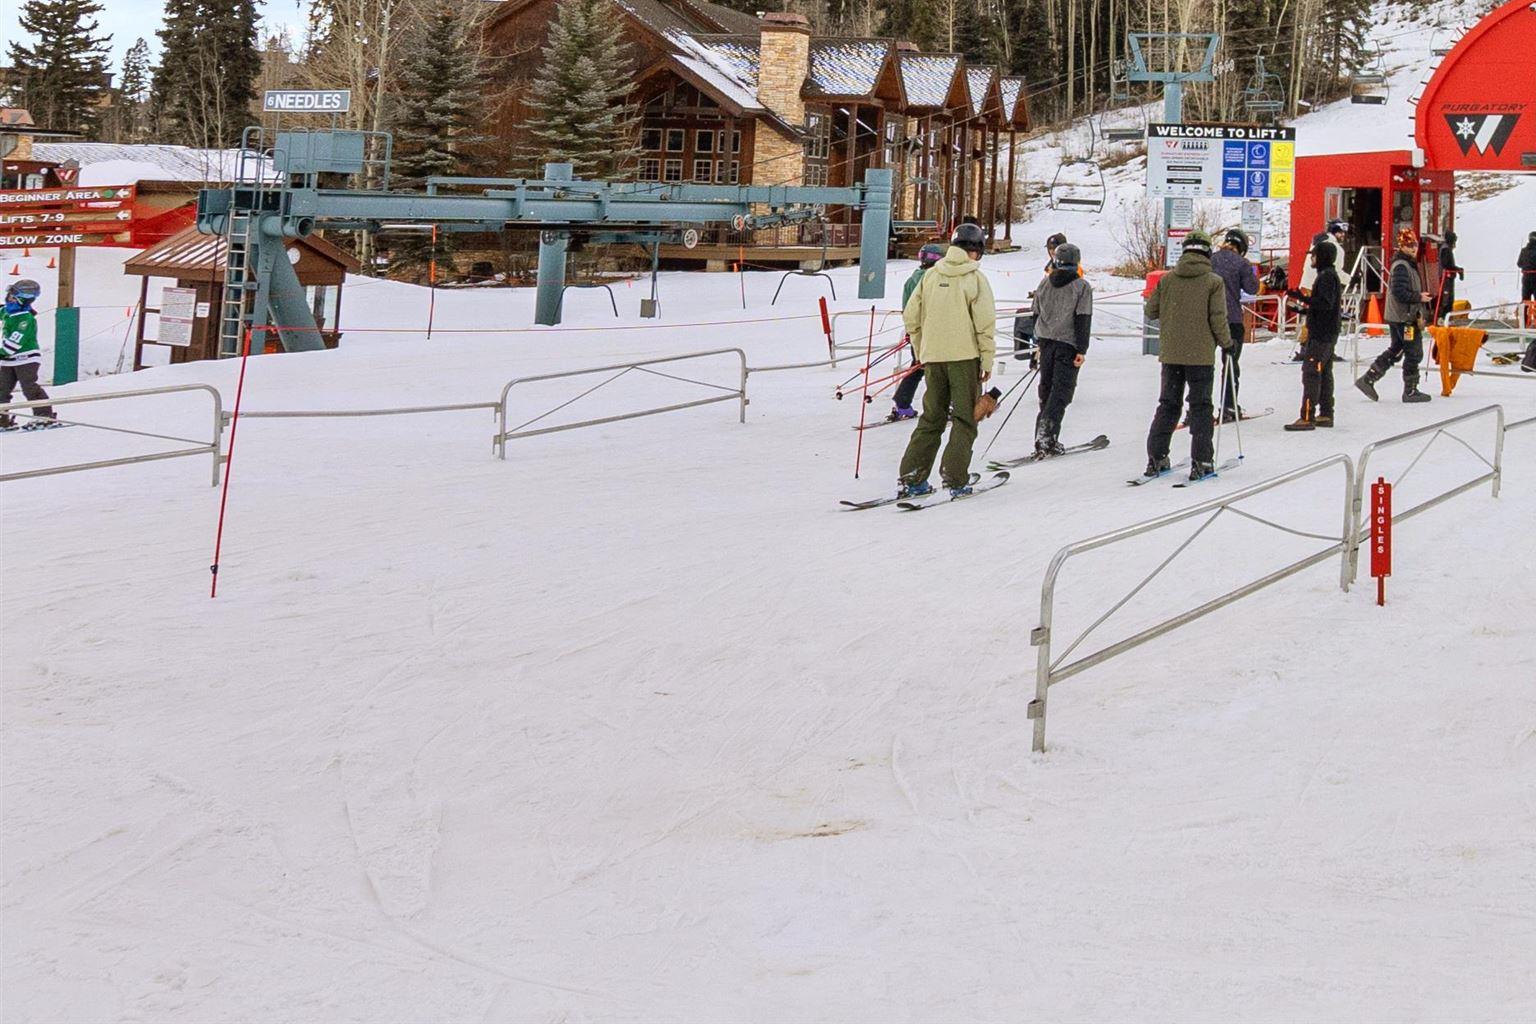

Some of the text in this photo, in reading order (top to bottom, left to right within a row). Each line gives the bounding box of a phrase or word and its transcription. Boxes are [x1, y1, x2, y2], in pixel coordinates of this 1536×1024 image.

[267, 93, 341, 109] 6 NEEDLES
[1440, 103, 1527, 112] PURGATORY
[1156, 126, 1286, 139] WELCOME TO LIFT 1
[0, 191, 101, 202] BEGINNER AREA
[0, 213, 65, 224] LIFTS 7-9
[0, 234, 83, 245] SLOW ZONE
[1377, 487, 1385, 554] SINGLES
